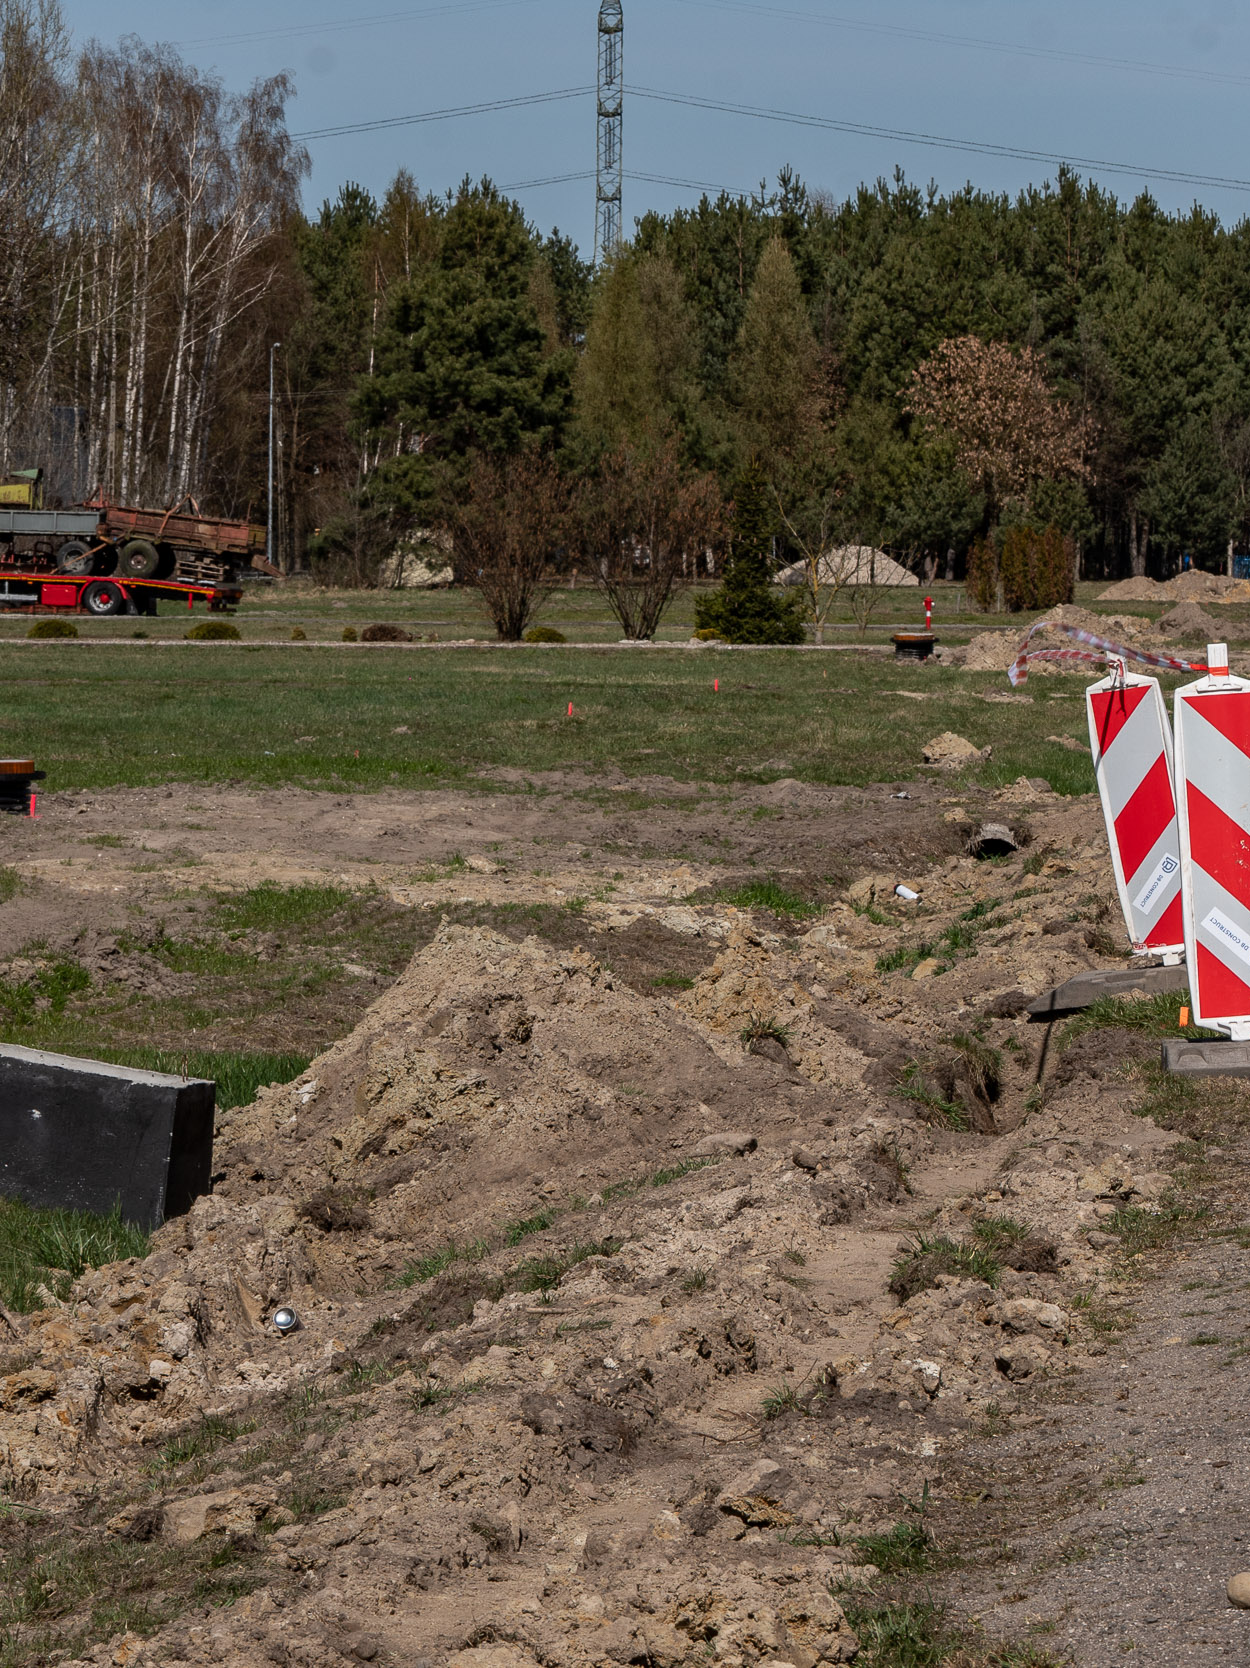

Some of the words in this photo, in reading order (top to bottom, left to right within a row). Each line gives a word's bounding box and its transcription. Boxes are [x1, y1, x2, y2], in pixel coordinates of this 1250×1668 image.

[1157, 874, 1164, 882] DB
[1140, 881, 1159, 908] CONSTRUCT
[1209, 917, 1241, 944] CONSTRUCT
[1240, 942, 1250, 951] DB
